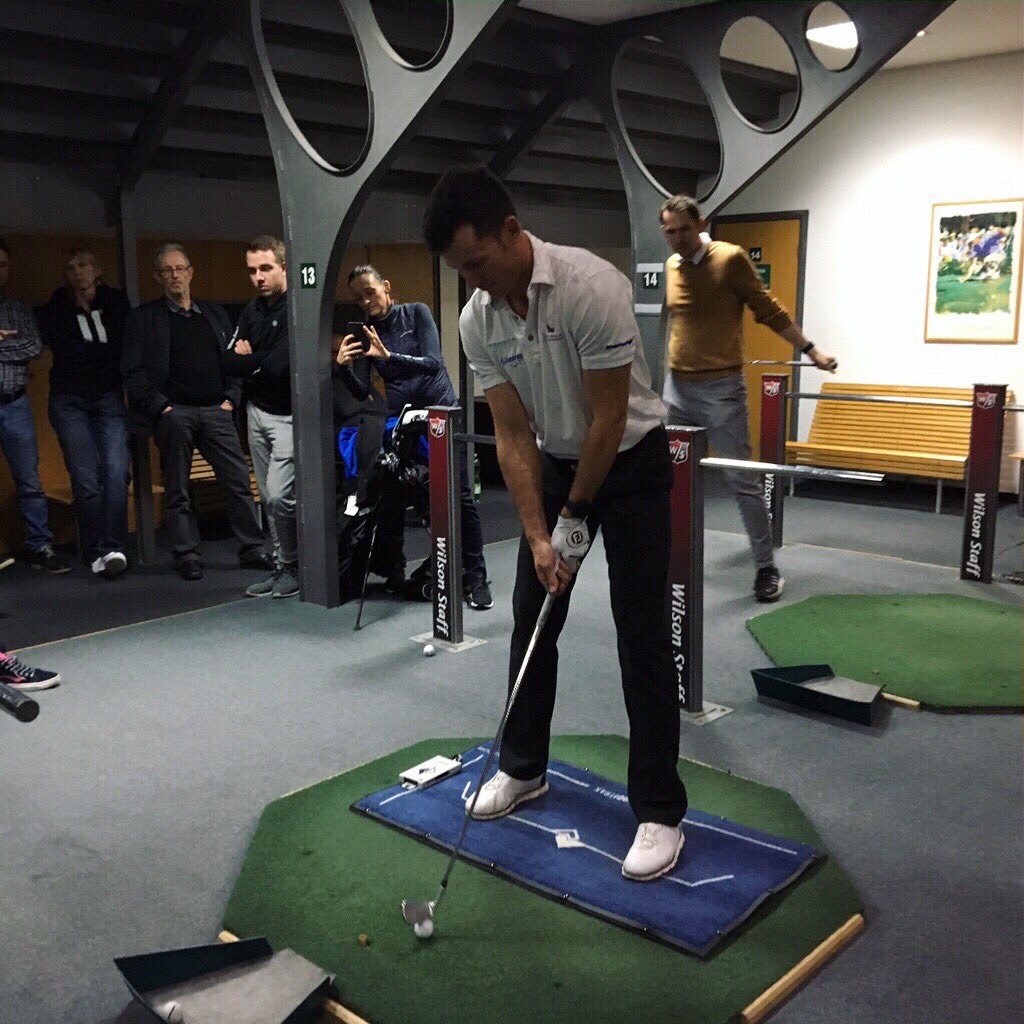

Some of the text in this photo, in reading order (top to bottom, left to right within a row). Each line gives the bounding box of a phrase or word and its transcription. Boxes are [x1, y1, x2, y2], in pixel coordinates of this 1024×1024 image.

[301, 266, 316, 285] 13
[644, 272, 658, 286] 14
[966, 492, 986, 579] Wilson Staff
[436, 536, 448, 637] Wilson Staff
[671, 583, 686, 647] Wilson
